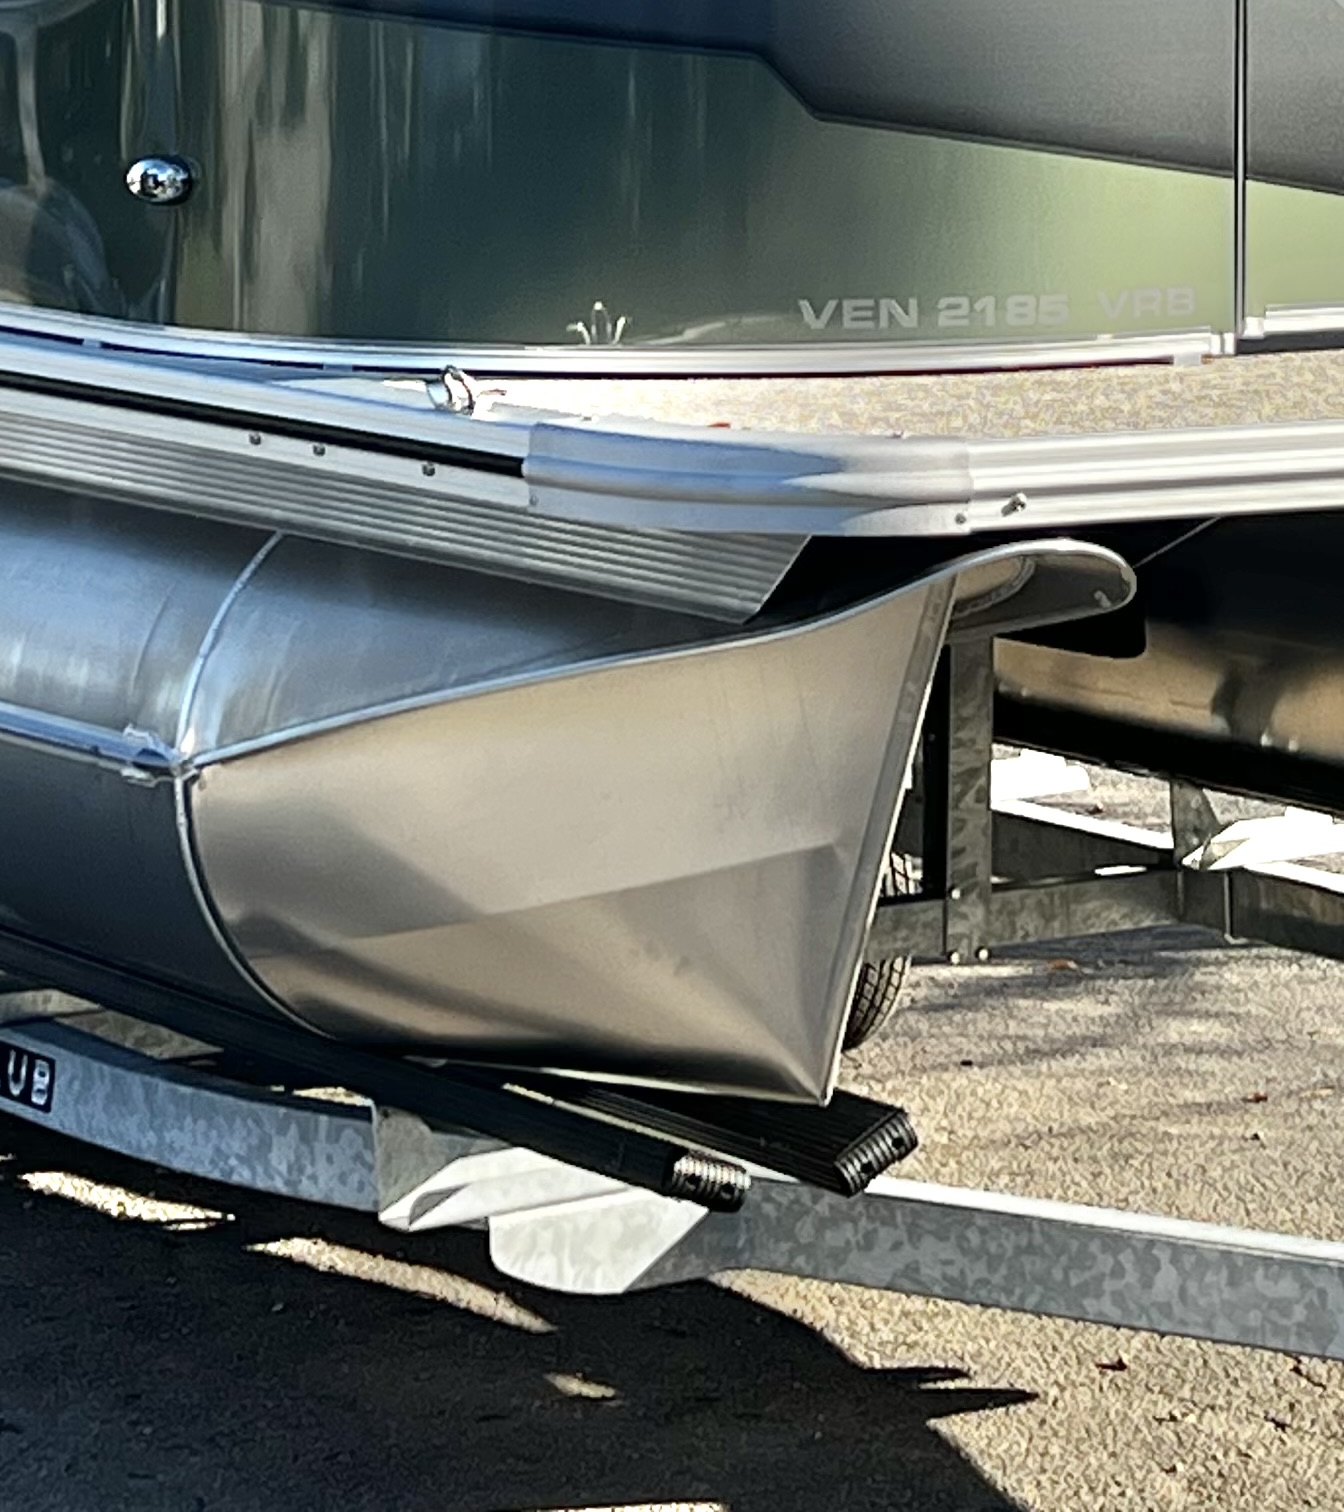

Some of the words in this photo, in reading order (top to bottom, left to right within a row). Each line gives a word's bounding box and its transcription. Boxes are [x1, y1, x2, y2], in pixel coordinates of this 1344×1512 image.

[797, 297, 919, 330] VEN
[937, 294, 1072, 327] 2185
[1096, 287, 1197, 320] VRB
